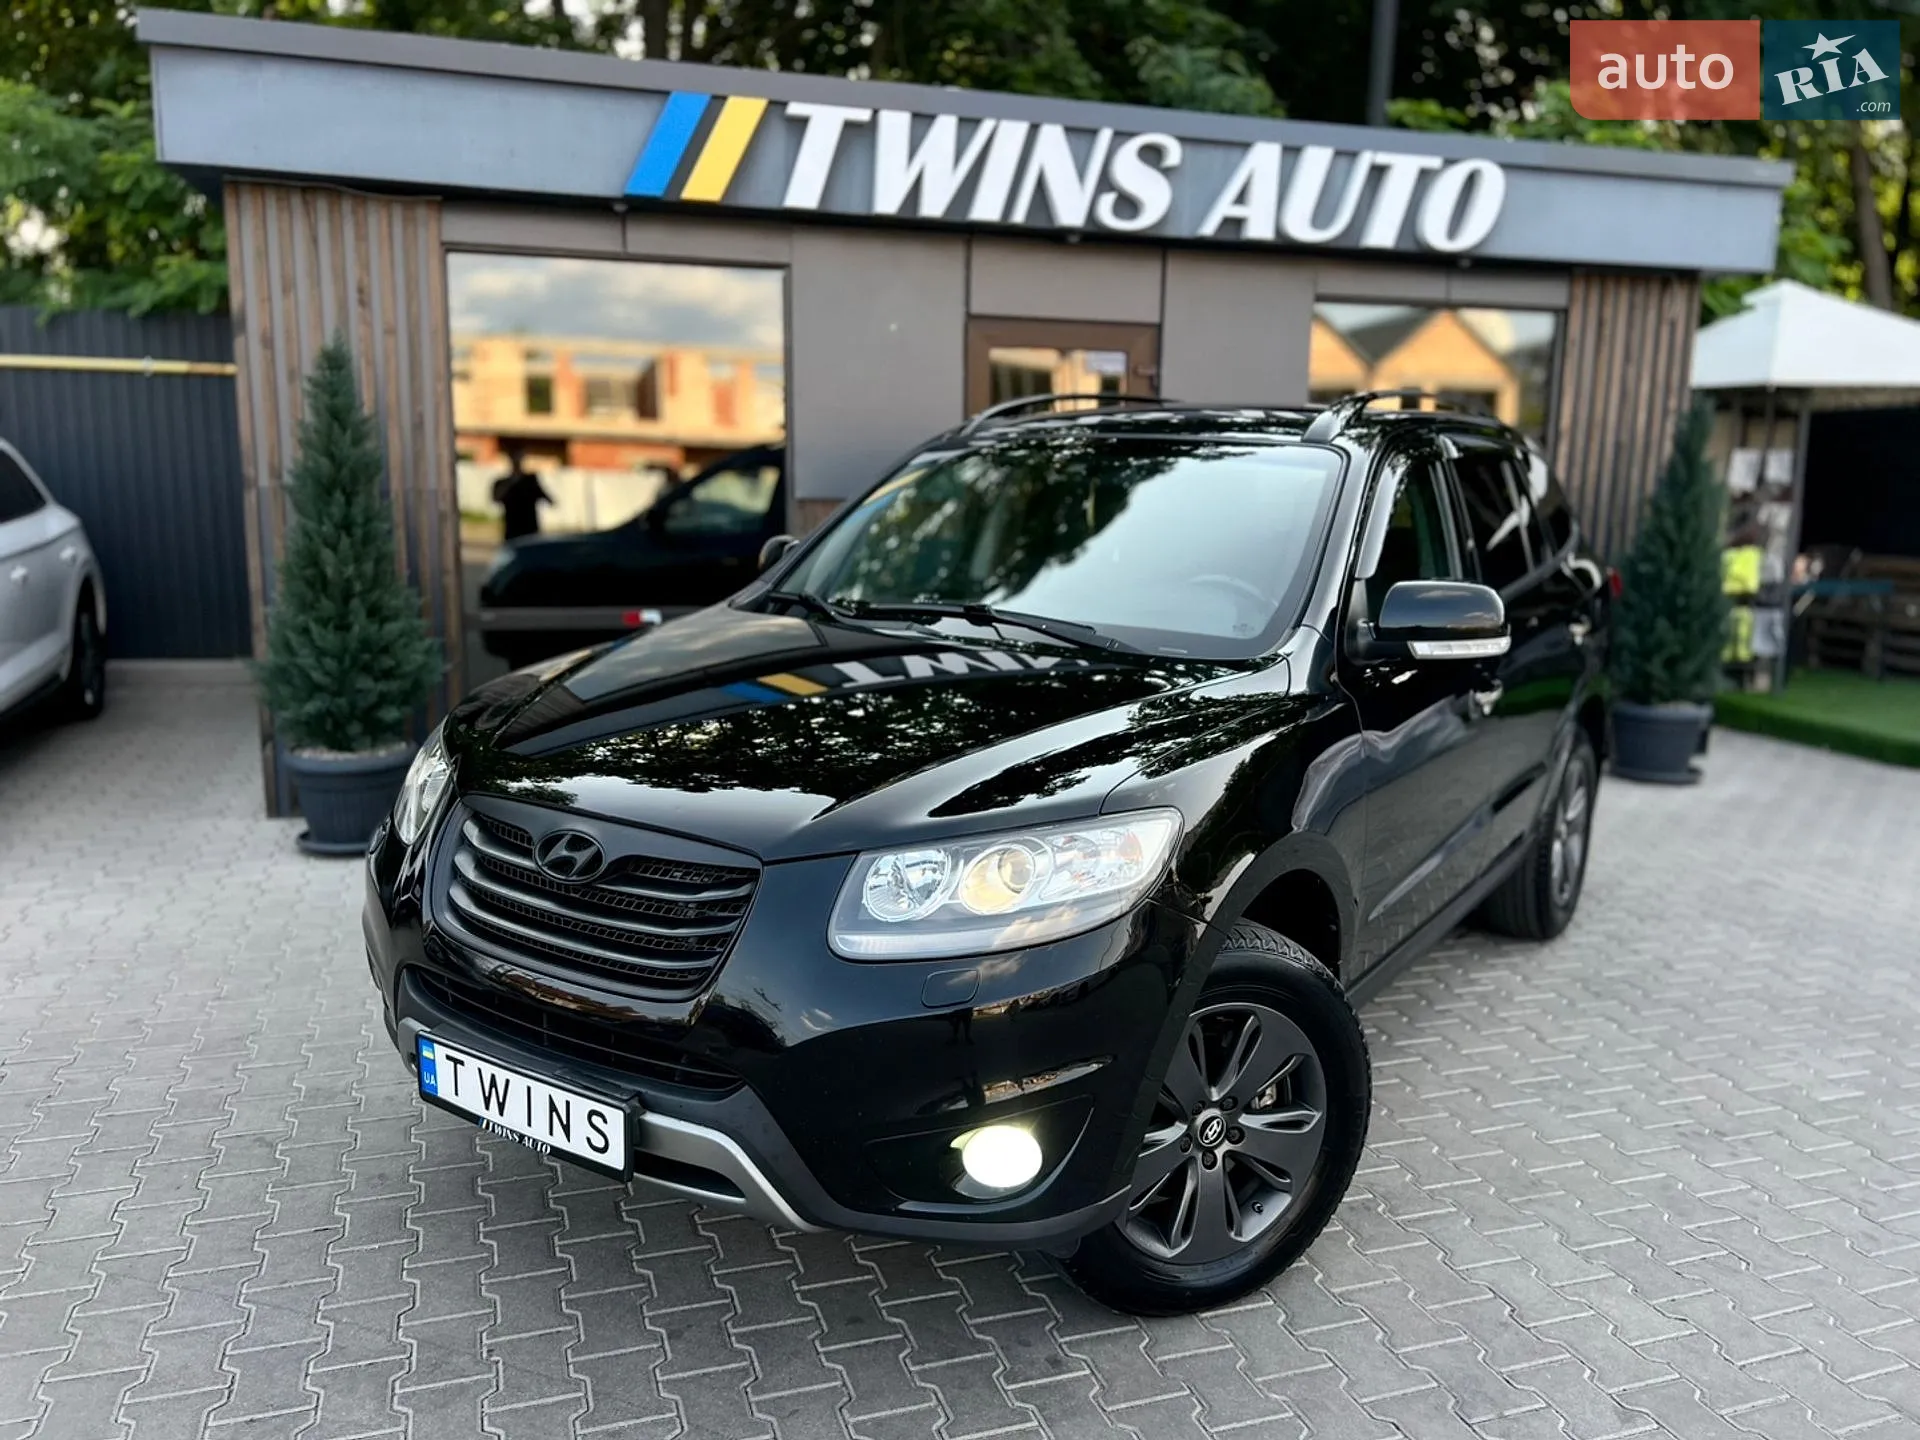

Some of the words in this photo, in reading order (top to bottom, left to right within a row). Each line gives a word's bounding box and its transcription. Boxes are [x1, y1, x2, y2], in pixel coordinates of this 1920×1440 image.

[783, 100, 1184, 232] TWINS
[1195, 140, 1507, 253] AUTO
[423, 1071, 437, 1087] UA
[445, 1053, 610, 1155] TWINS
[487, 1121, 520, 1143] TWINS
[522, 1135, 551, 1156] AUTO
